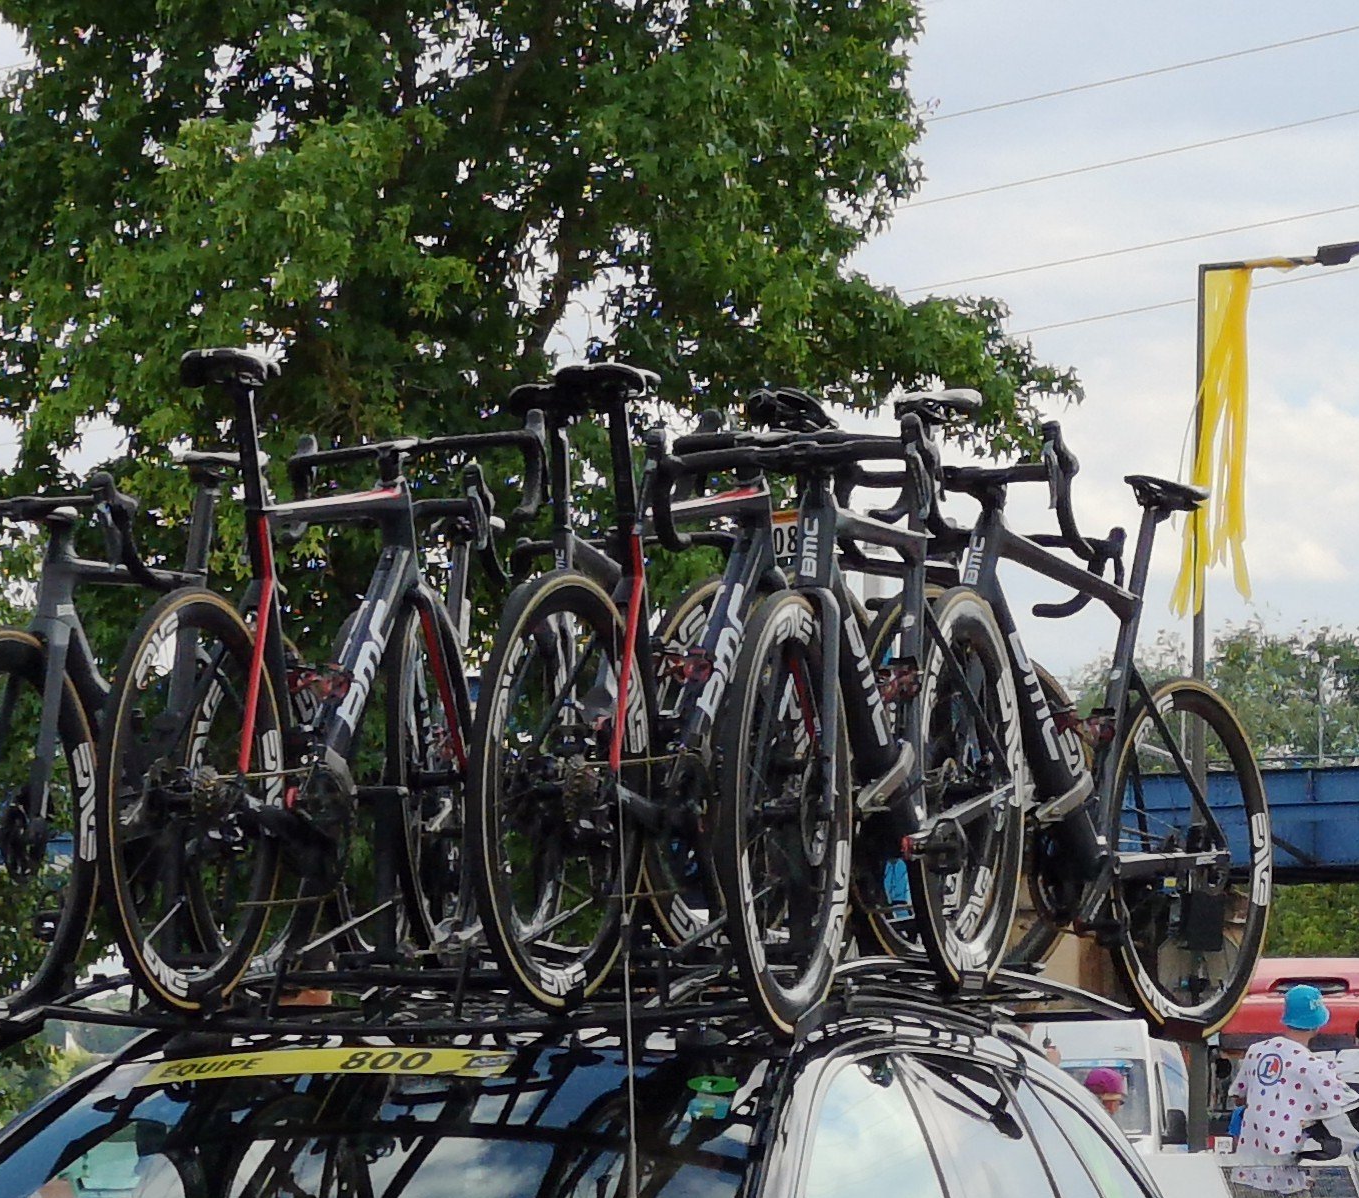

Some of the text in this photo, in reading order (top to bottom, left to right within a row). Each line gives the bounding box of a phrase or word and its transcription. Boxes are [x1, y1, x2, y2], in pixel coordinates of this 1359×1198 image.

[800, 517, 819, 578] BMC
[962, 535, 986, 585] BMC
[1252, 812, 1273, 907] ENVE
[339, 1051, 433, 1070] 800
